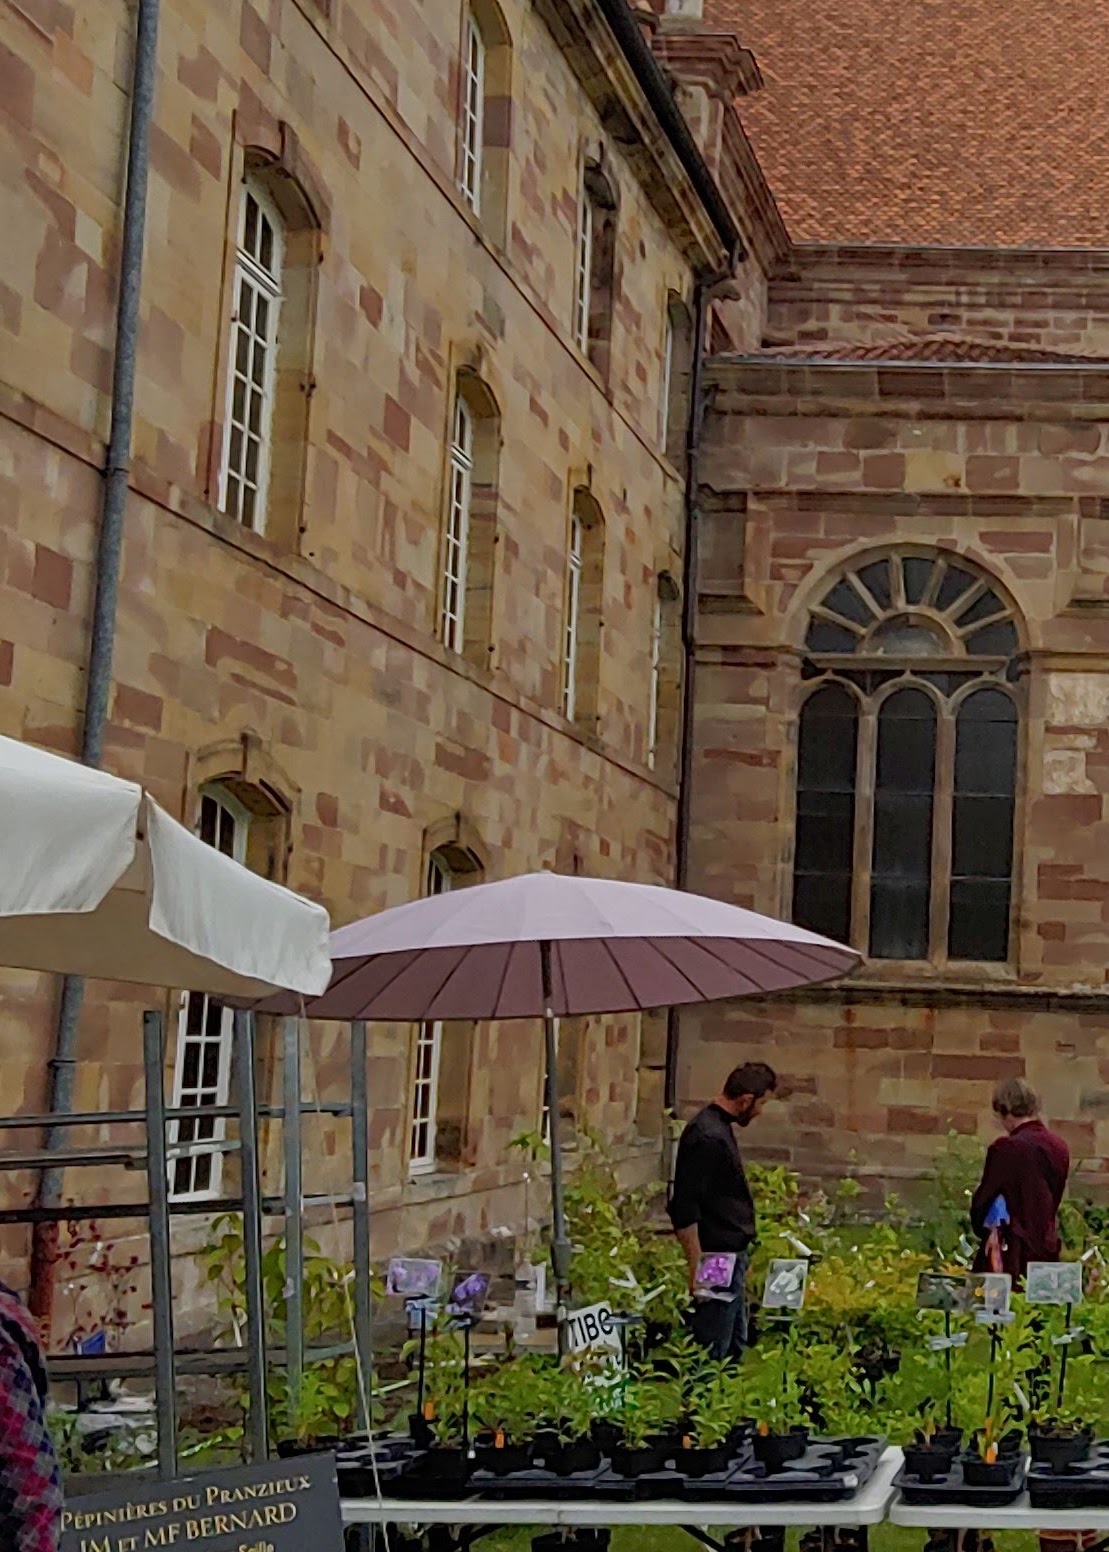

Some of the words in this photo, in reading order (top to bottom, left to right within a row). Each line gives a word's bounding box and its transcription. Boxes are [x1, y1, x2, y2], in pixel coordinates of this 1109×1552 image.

[172, 1494, 201, 1512] DU
[205, 1474, 312, 1506] PRANZIEUX
[118, 1536, 139, 1552] ET
[144, 1523, 181, 1548] MF
[186, 1501, 297, 1540] BERNARD
